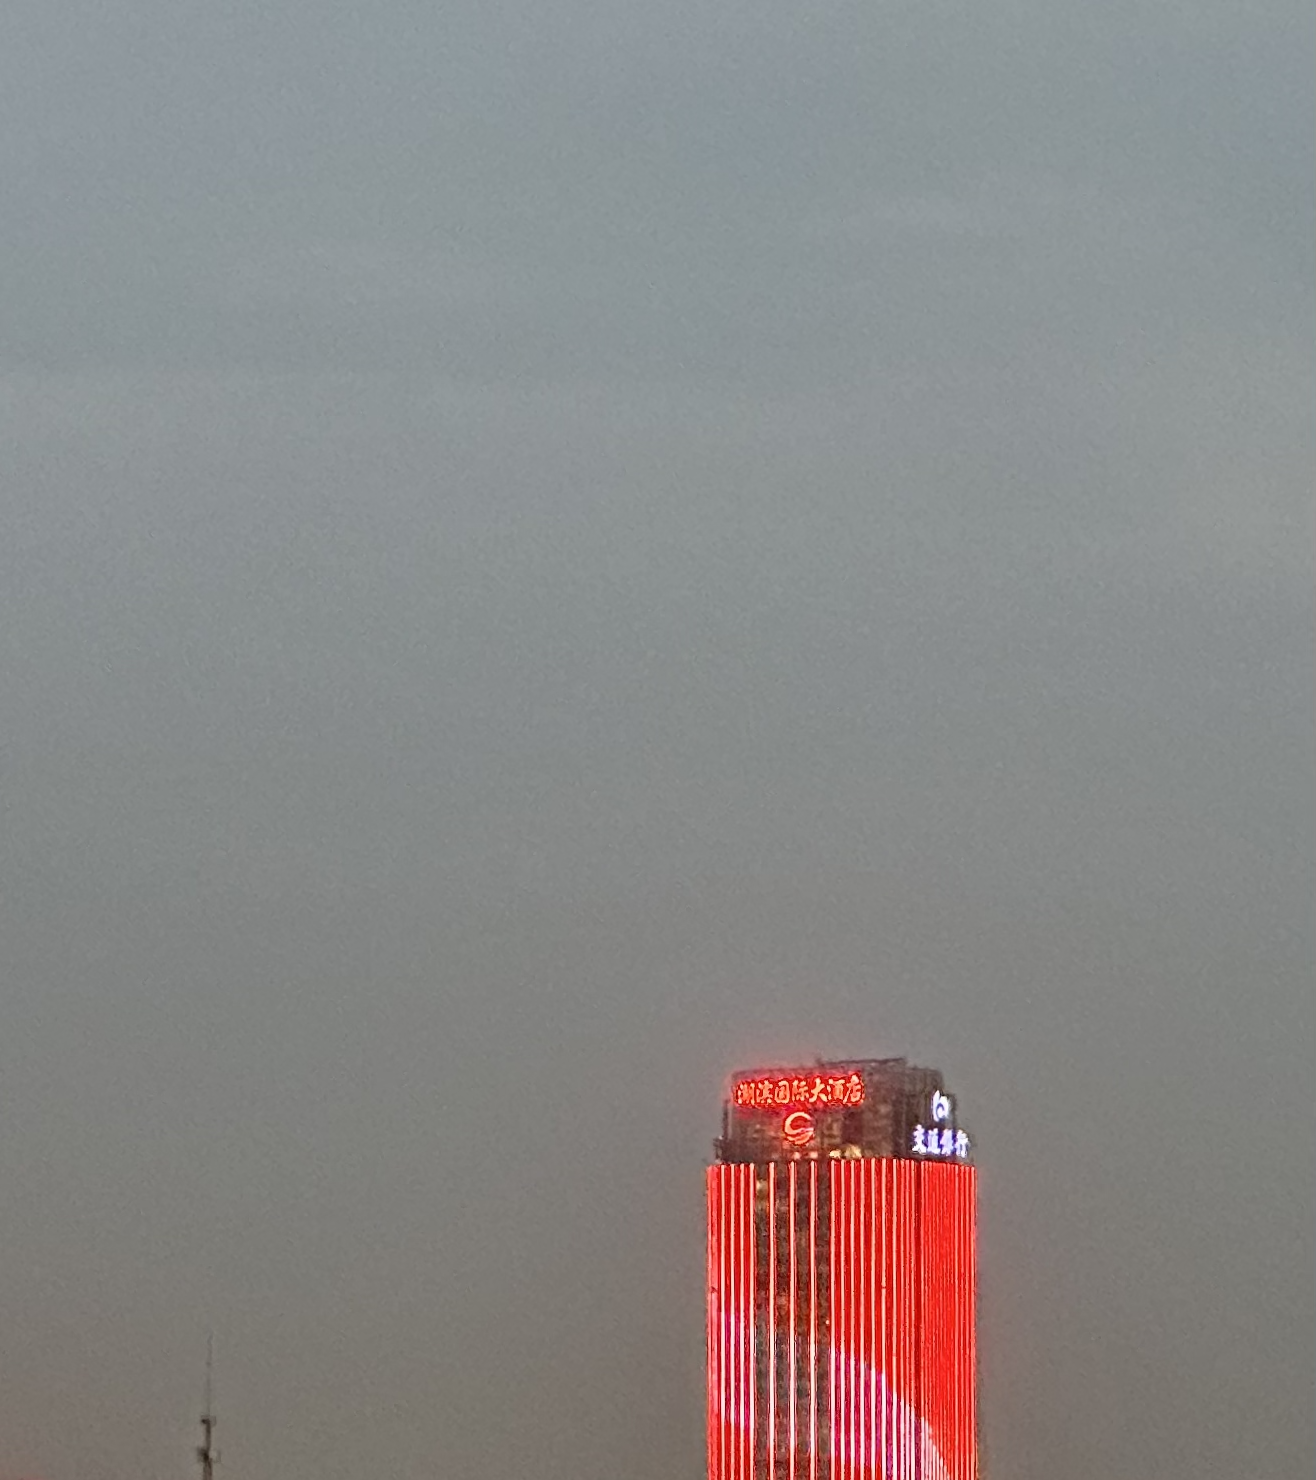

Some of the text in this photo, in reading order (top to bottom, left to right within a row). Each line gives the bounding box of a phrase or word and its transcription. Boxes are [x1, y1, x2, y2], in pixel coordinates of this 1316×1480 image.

[736, 1073, 865, 1105] 湖滨国际大酒店
[911, 1123, 970, 1159] 交通银行
